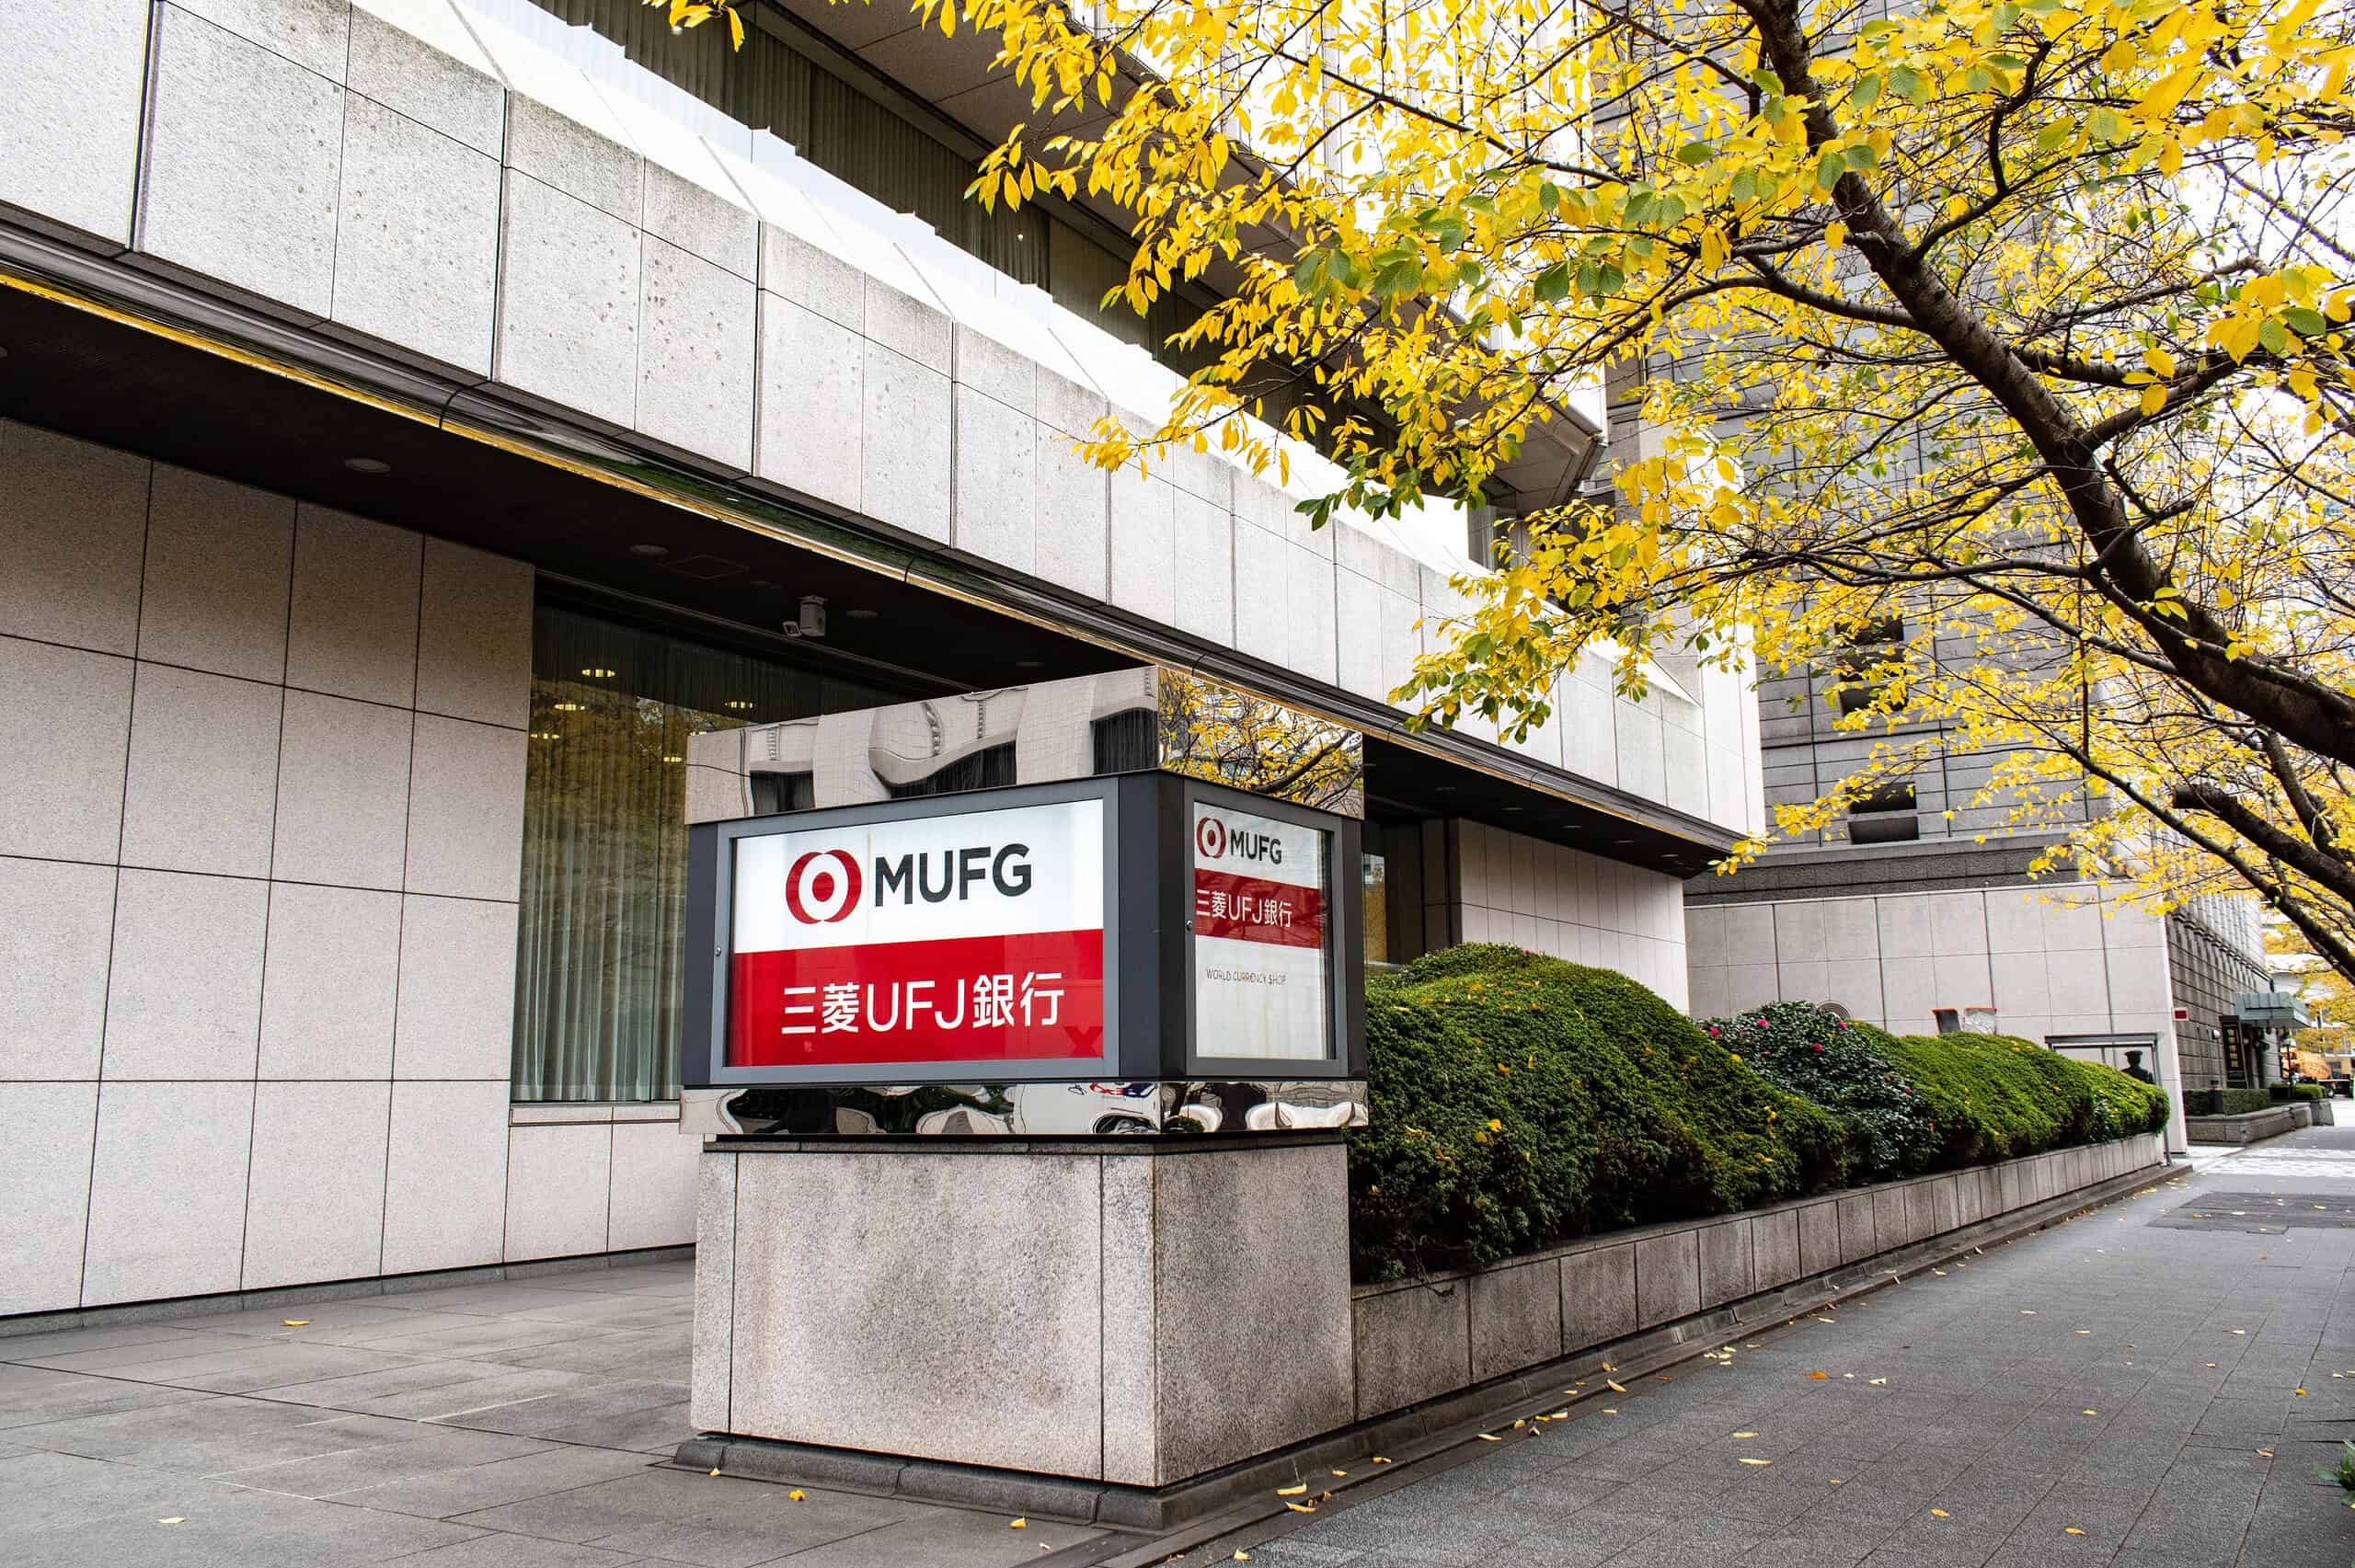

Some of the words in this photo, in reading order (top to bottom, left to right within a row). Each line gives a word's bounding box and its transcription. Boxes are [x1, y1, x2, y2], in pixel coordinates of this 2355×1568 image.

[1230, 829, 1282, 865] MUFG
[876, 843, 1031, 907] MUFG
[1196, 889, 1292, 928] 三菱UFJ銀行
[1206, 967, 1231, 981] WORLD
[1269, 974, 1287, 985] SHOP
[782, 971, 1064, 1036] 三菱UFJ銀行
